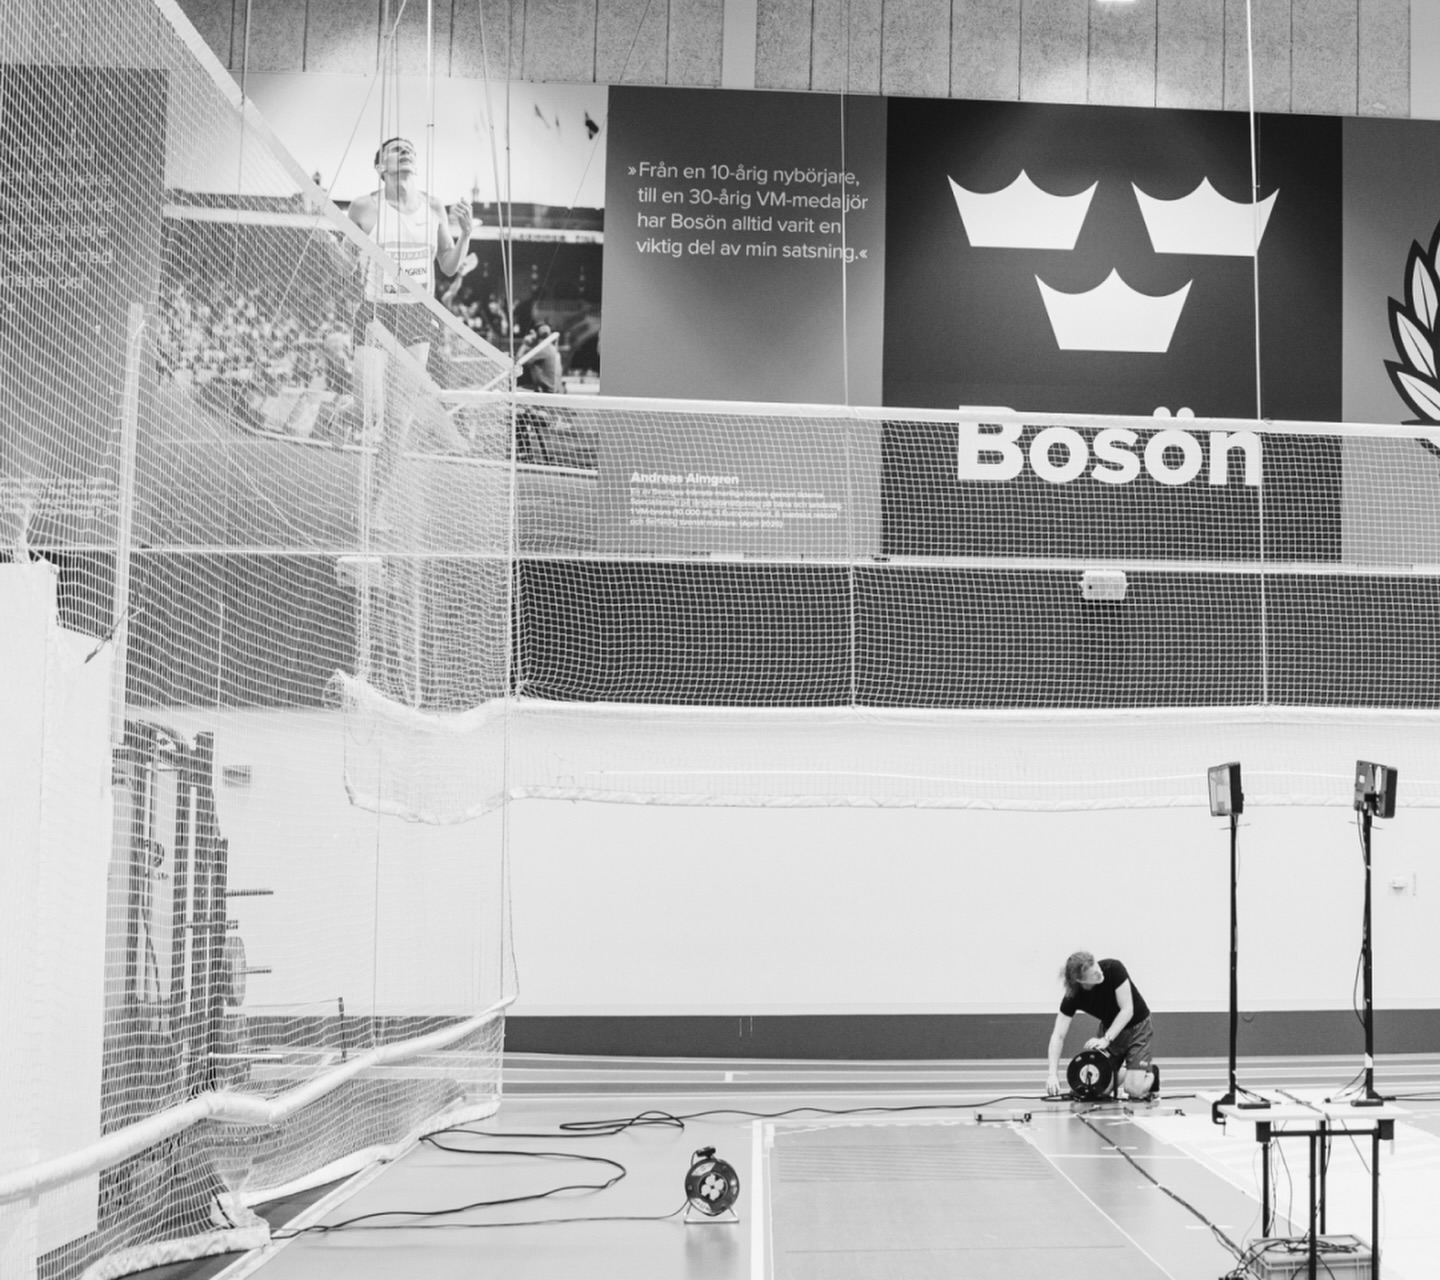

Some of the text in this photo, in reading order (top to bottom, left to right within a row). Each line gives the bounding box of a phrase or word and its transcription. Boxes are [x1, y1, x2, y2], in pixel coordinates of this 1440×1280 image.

[683, 165, 705, 180] en
[710, 163, 768, 185] 10-årig
[773, 166, 860, 187] nybörjare,
[637, 187, 868, 212] till en 30-årig VM-medajör
[637, 213, 841, 235] har Bosön alltid varit en
[636, 238, 683, 258] viktig
[688, 240, 715, 256] del
[720, 243, 740, 257] av
[745, 241, 777, 258] min
[957, 405, 1260, 487] Bosön
[630, 471, 739, 487] Andreas Almgren
